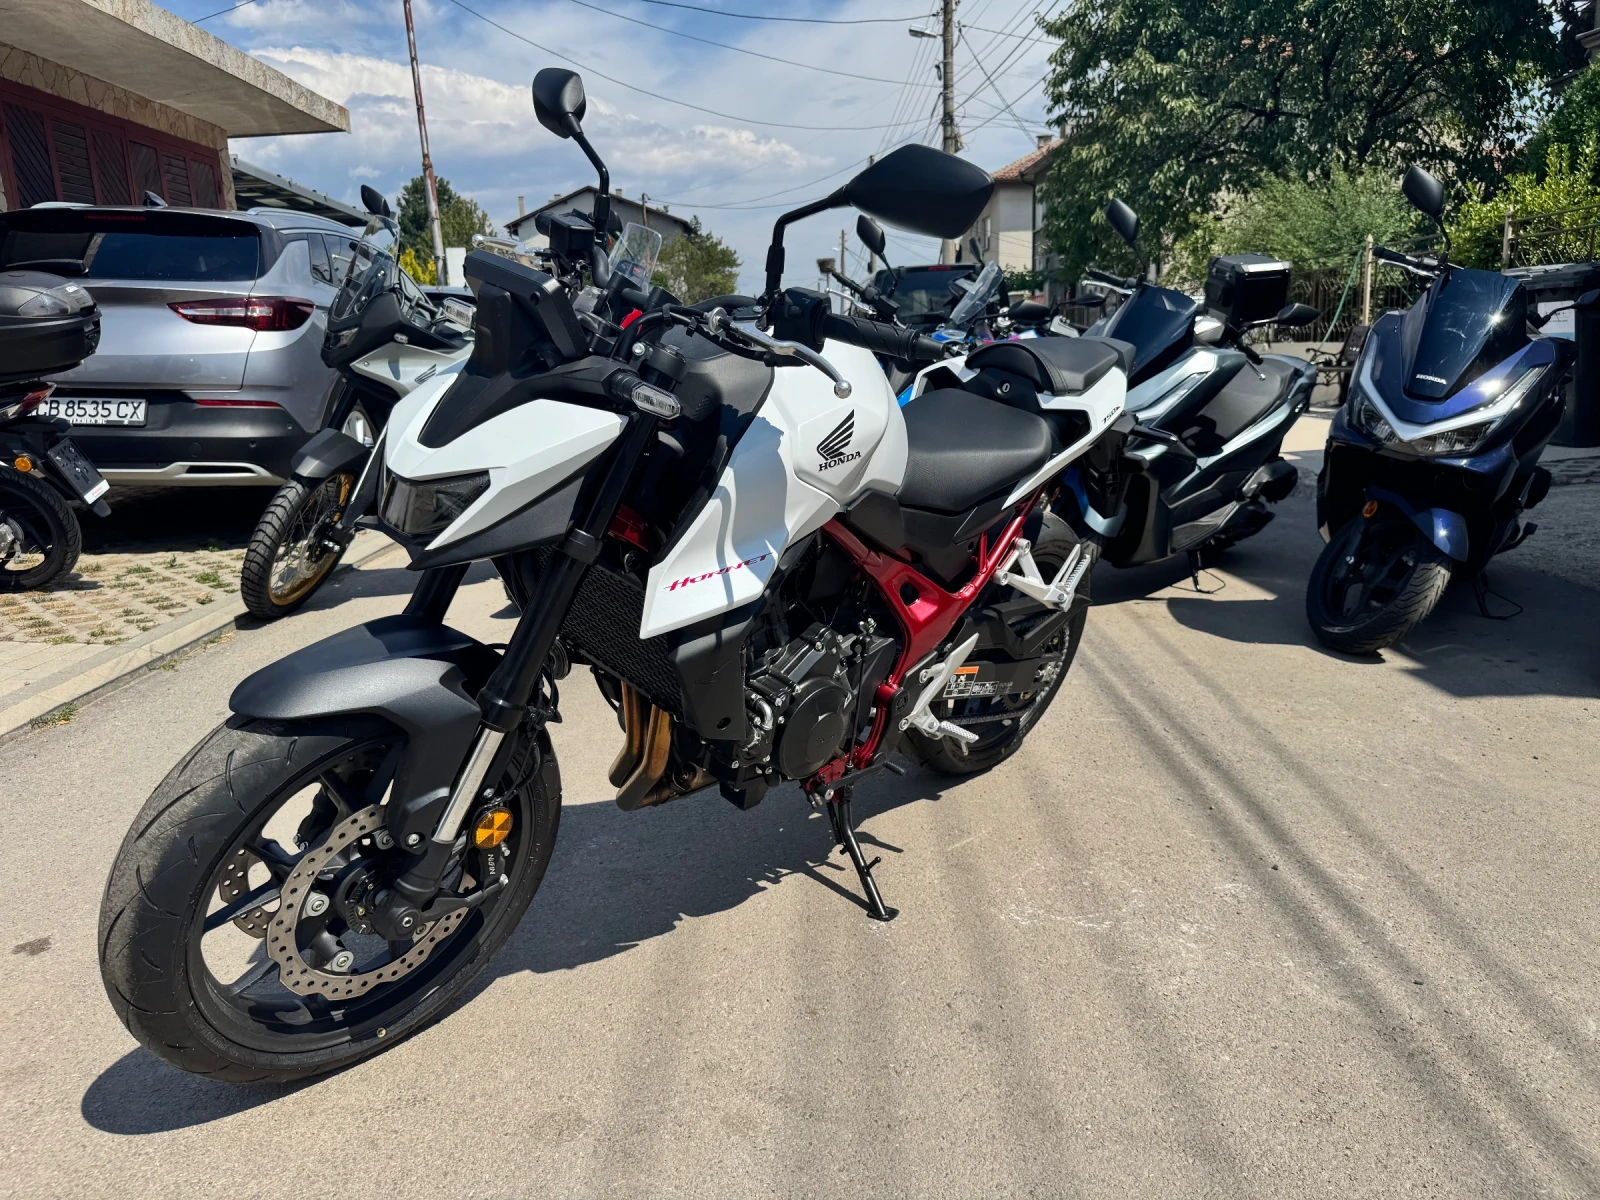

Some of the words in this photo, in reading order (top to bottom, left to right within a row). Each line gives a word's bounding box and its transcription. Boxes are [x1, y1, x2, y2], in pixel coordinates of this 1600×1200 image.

[1416, 373, 1447, 385] HONDA
[35, 401, 60, 417] CB
[64, 400, 112, 418] 8535
[116, 401, 142, 419] CX
[818, 451, 862, 472] HONDA
